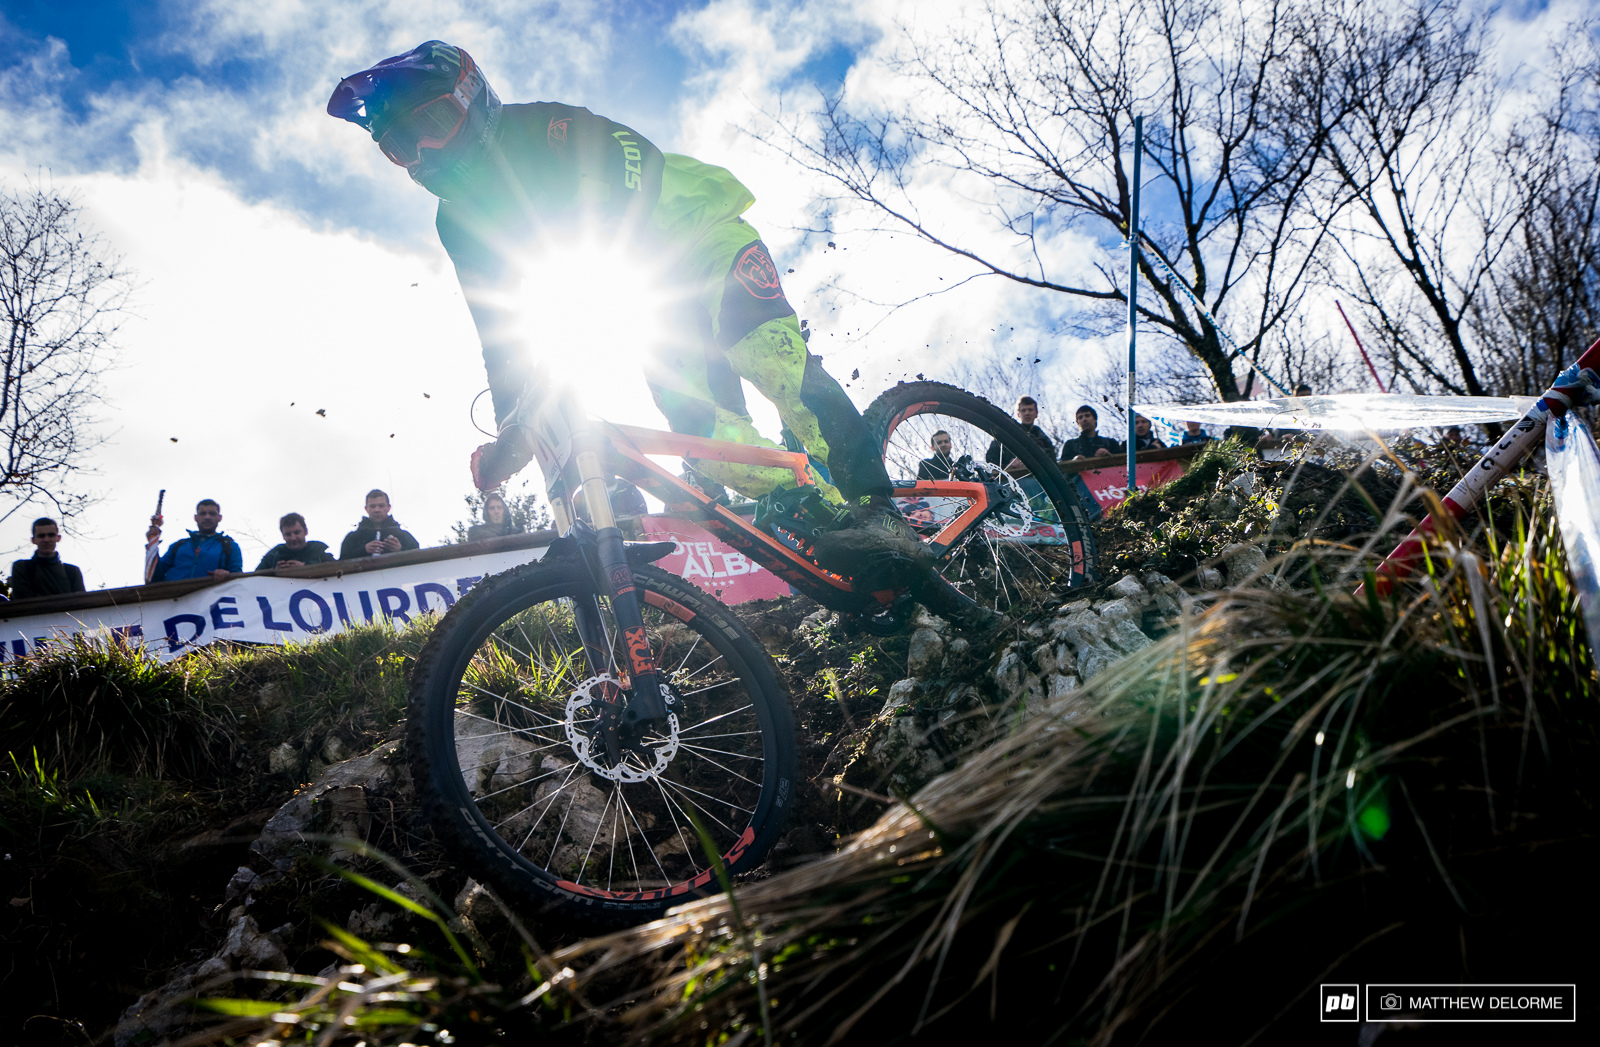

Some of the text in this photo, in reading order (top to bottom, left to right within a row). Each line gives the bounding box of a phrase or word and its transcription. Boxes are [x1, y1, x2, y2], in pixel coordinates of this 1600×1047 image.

[611, 130, 642, 192] SCOTT
[163, 596, 245, 653] DE
[632, 573, 741, 641] CHWALBE
[624, 627, 652, 675] FOX
